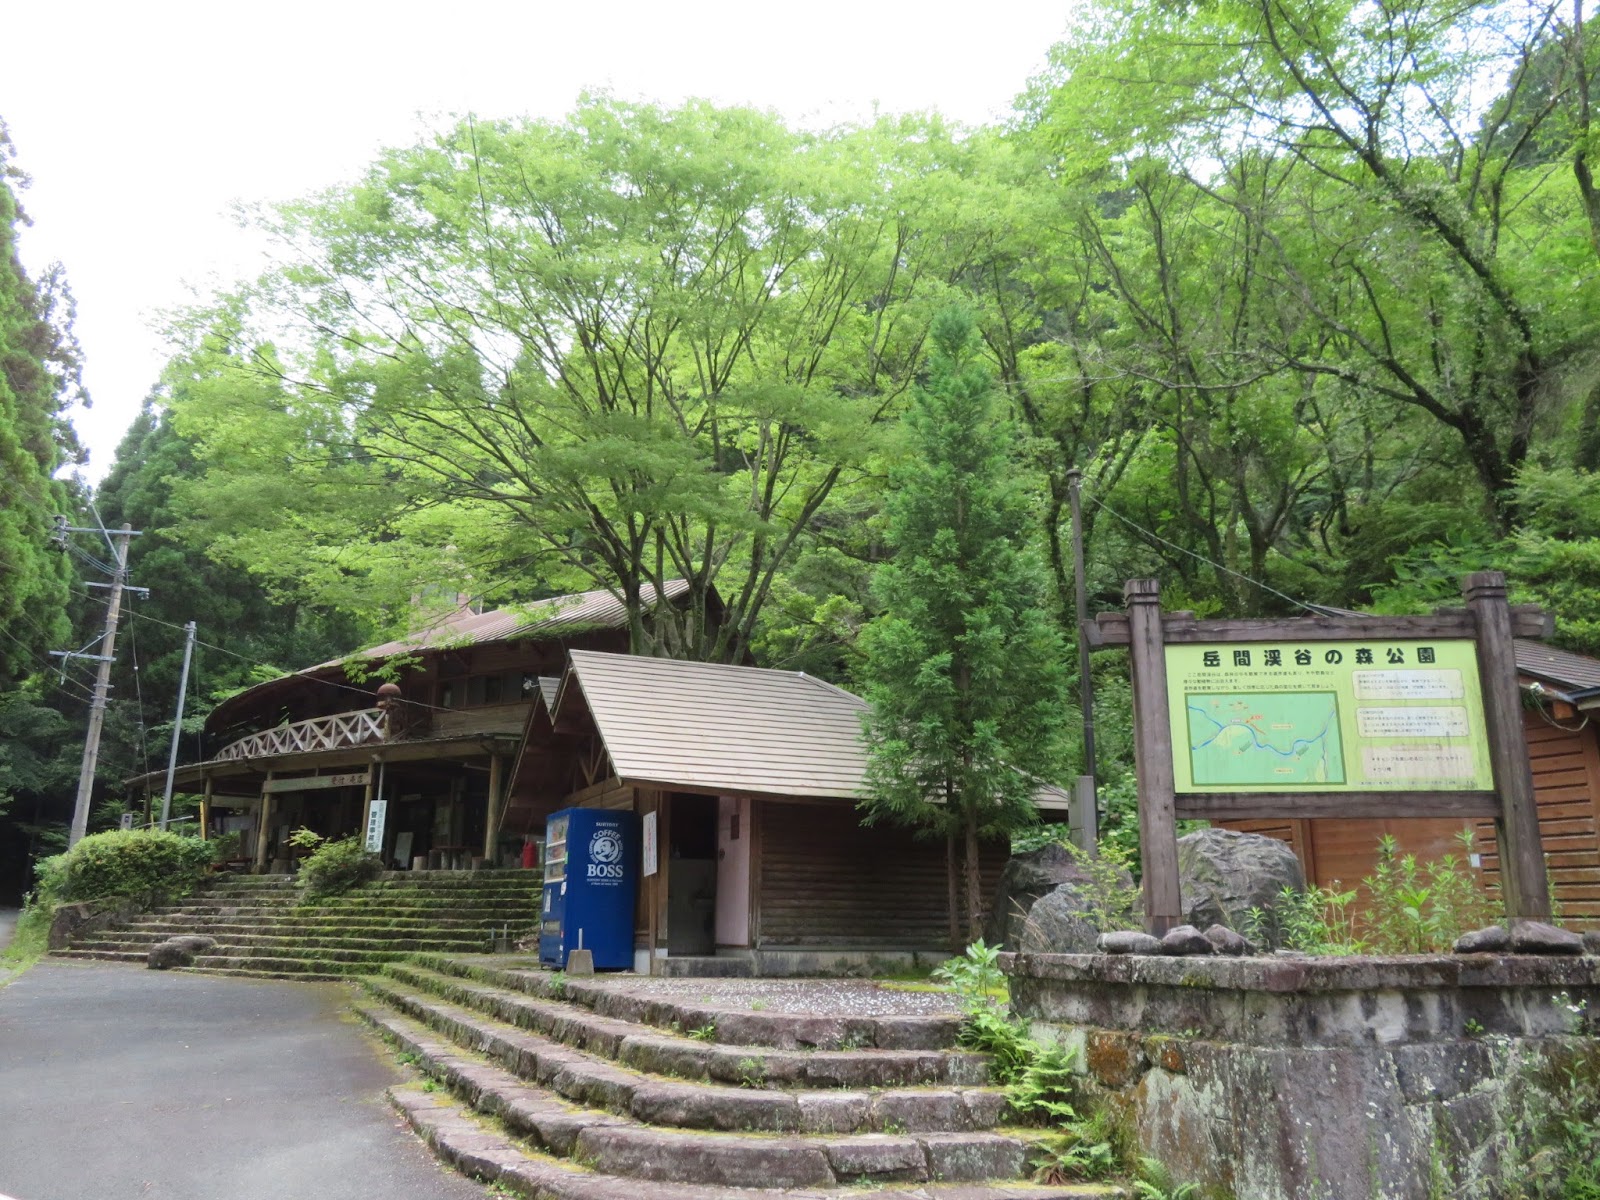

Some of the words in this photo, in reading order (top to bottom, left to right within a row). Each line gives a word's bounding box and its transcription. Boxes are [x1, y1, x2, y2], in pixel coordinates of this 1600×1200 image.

[1203, 647, 1435, 667] 岳間渓谷の森公園
[593, 830, 620, 840] COFFEE
[587, 864, 623, 877] BOSS
